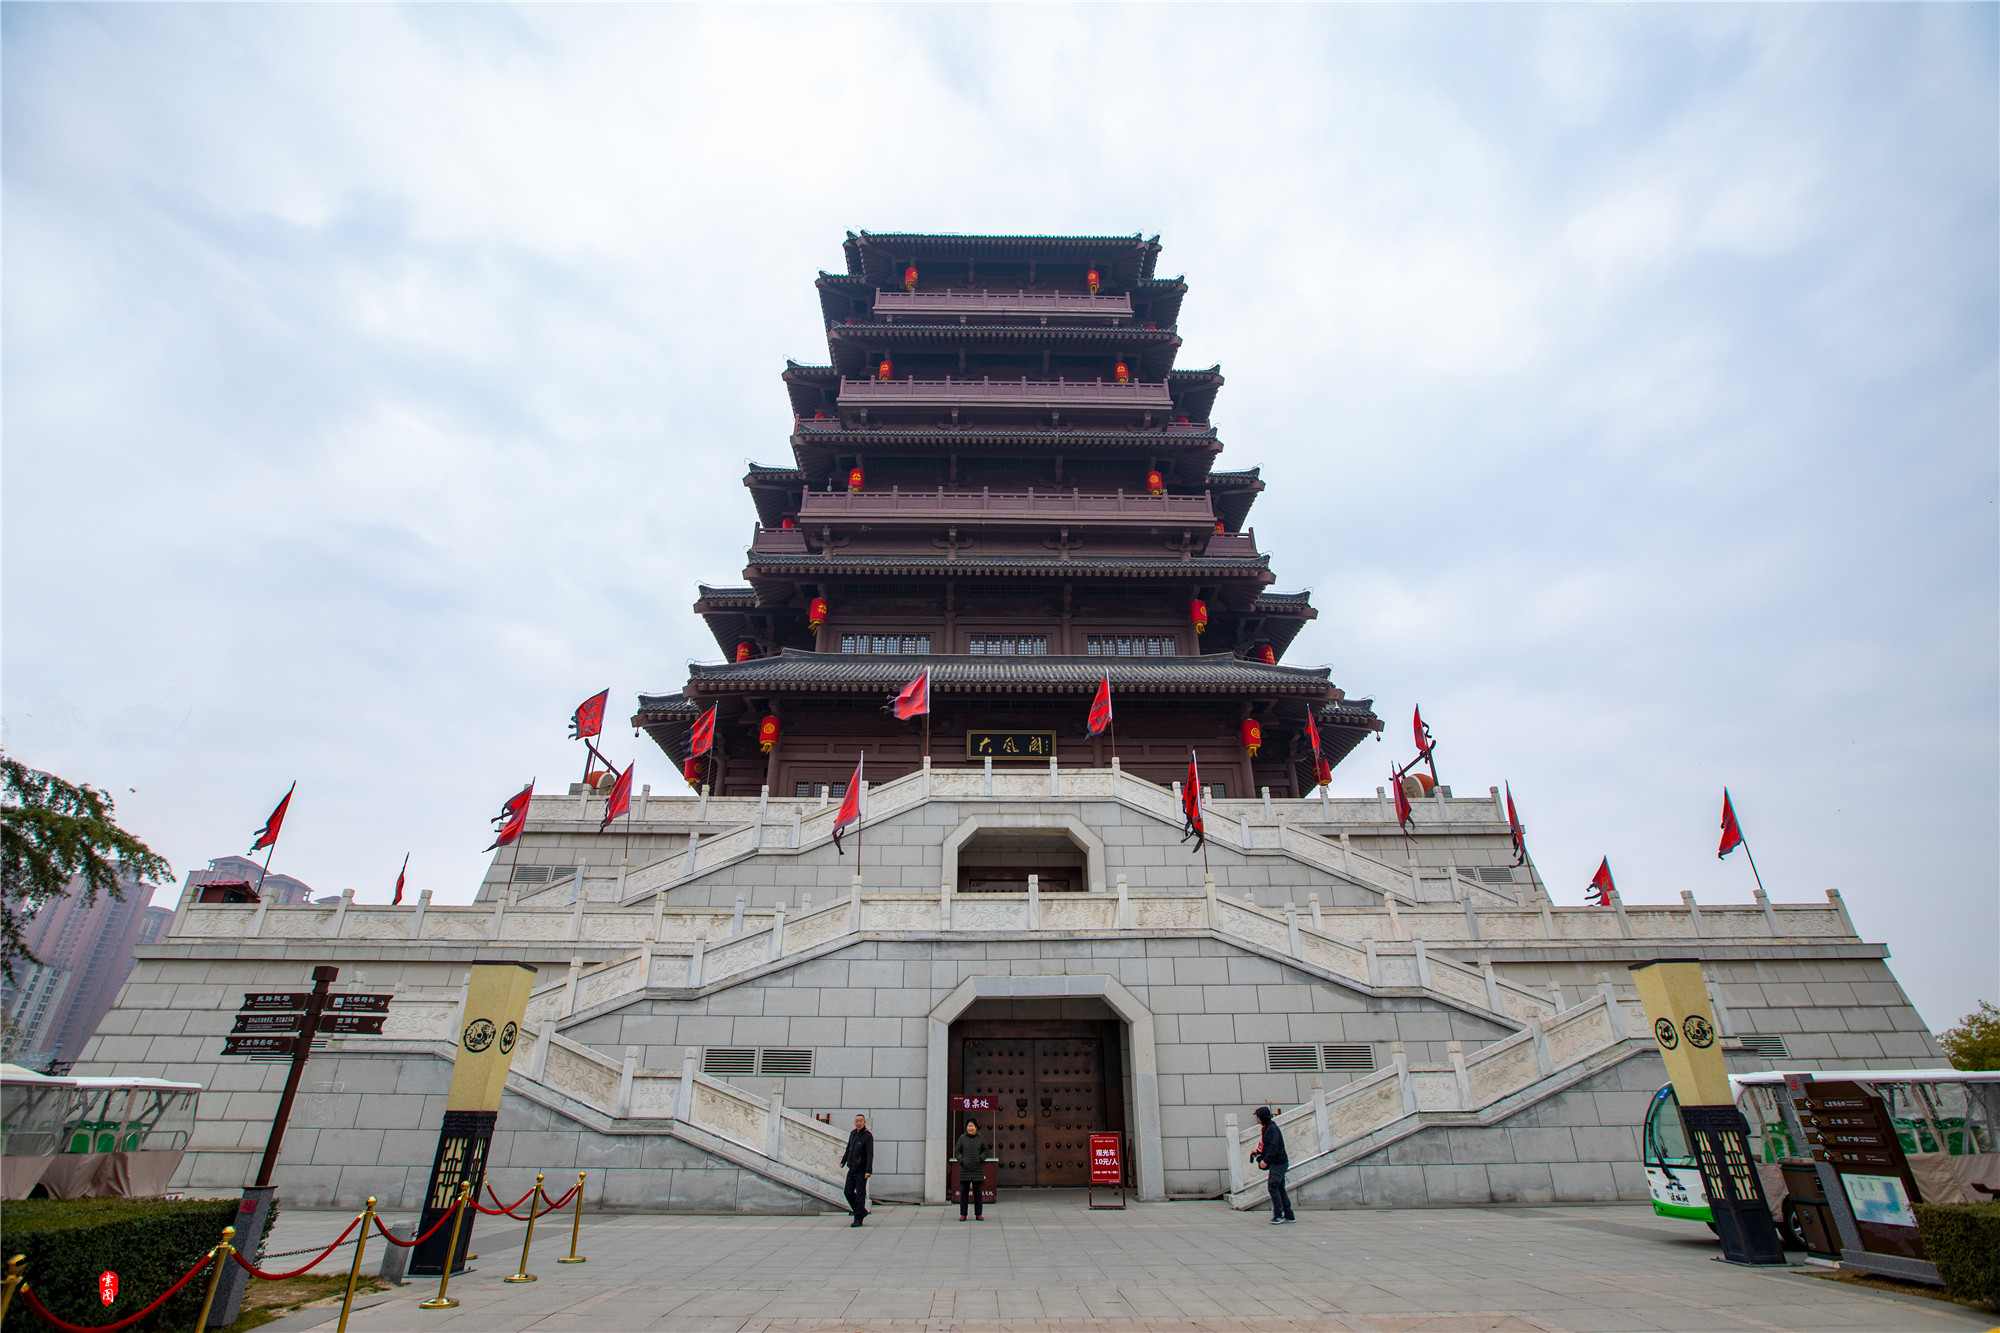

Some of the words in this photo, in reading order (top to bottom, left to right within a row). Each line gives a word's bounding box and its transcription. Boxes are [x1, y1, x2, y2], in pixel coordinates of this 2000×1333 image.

[963, 1098, 989, 1109] 售票处
[1095, 1149, 1116, 1157] 观光车
[1094, 1158, 1119, 1166] 10元/人
